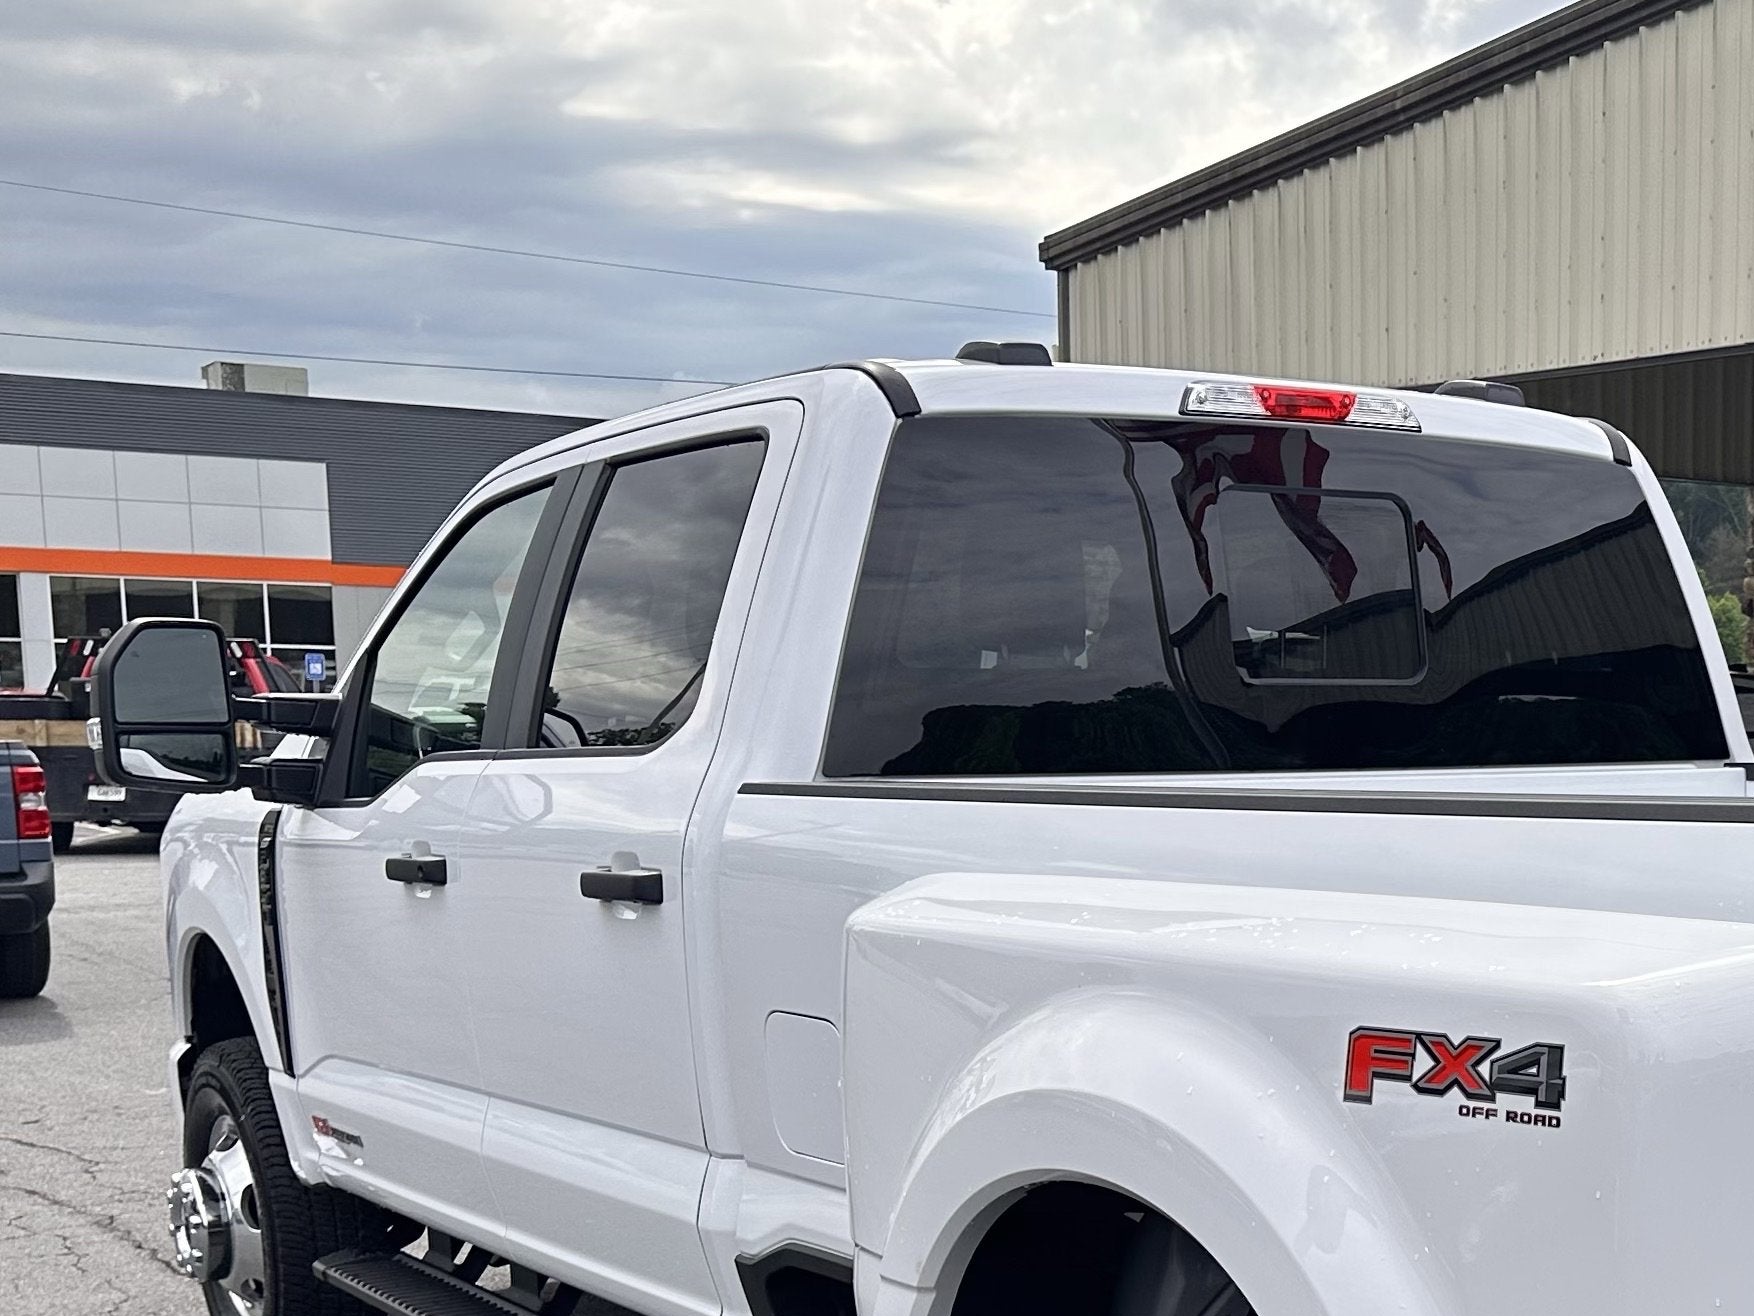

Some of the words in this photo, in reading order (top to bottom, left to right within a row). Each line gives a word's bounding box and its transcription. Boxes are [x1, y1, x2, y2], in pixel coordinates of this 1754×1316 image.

[1342, 1025, 1568, 1112] FX4
[1457, 1104, 1498, 1121] OFF
[1505, 1109, 1562, 1129] ROAD
